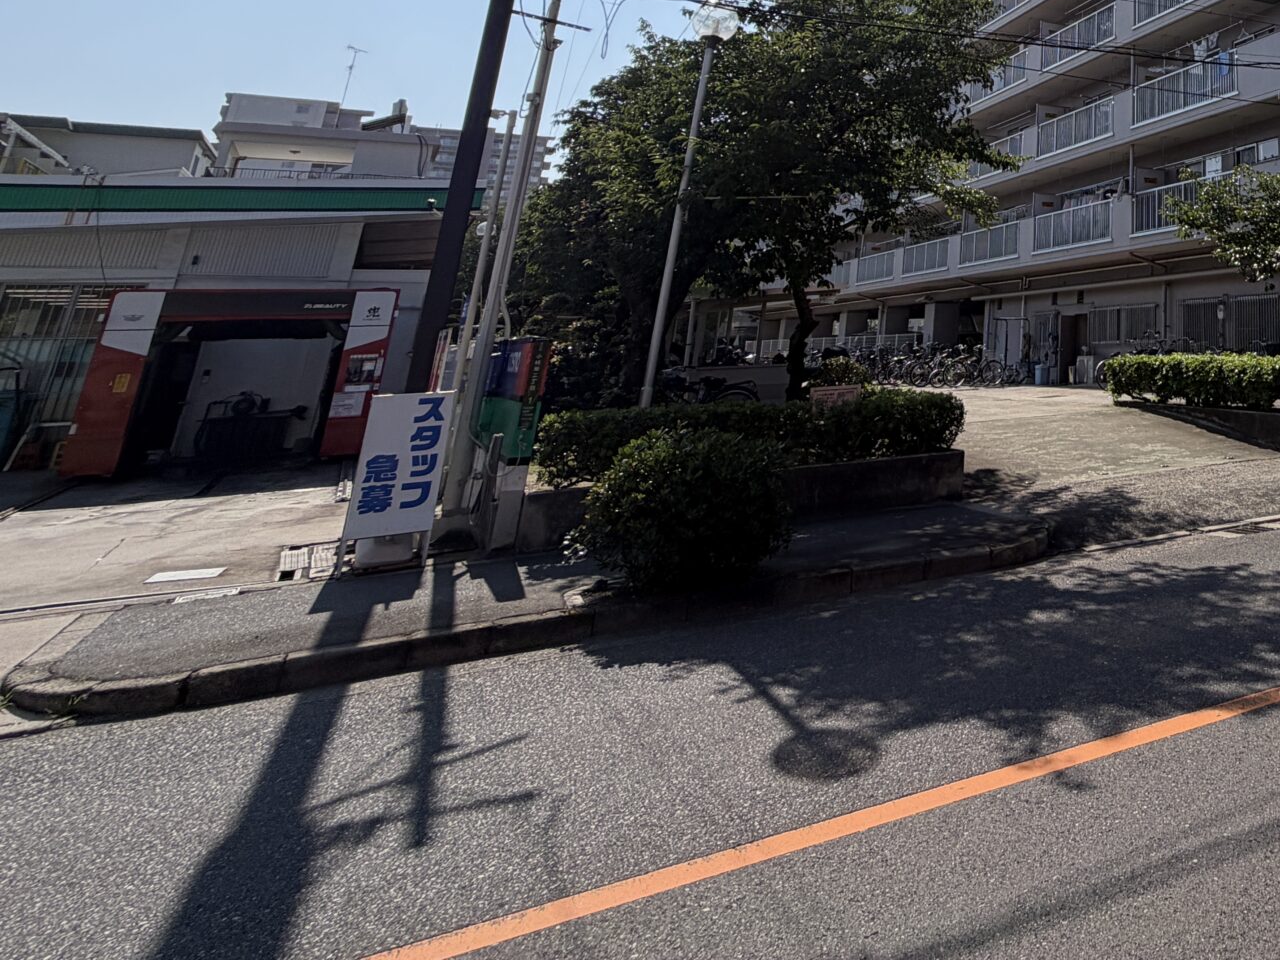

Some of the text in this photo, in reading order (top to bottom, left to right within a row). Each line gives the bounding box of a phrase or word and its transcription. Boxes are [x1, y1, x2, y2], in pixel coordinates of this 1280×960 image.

[356, 453, 400, 515] 急募
[399, 396, 446, 510] スタッフ
